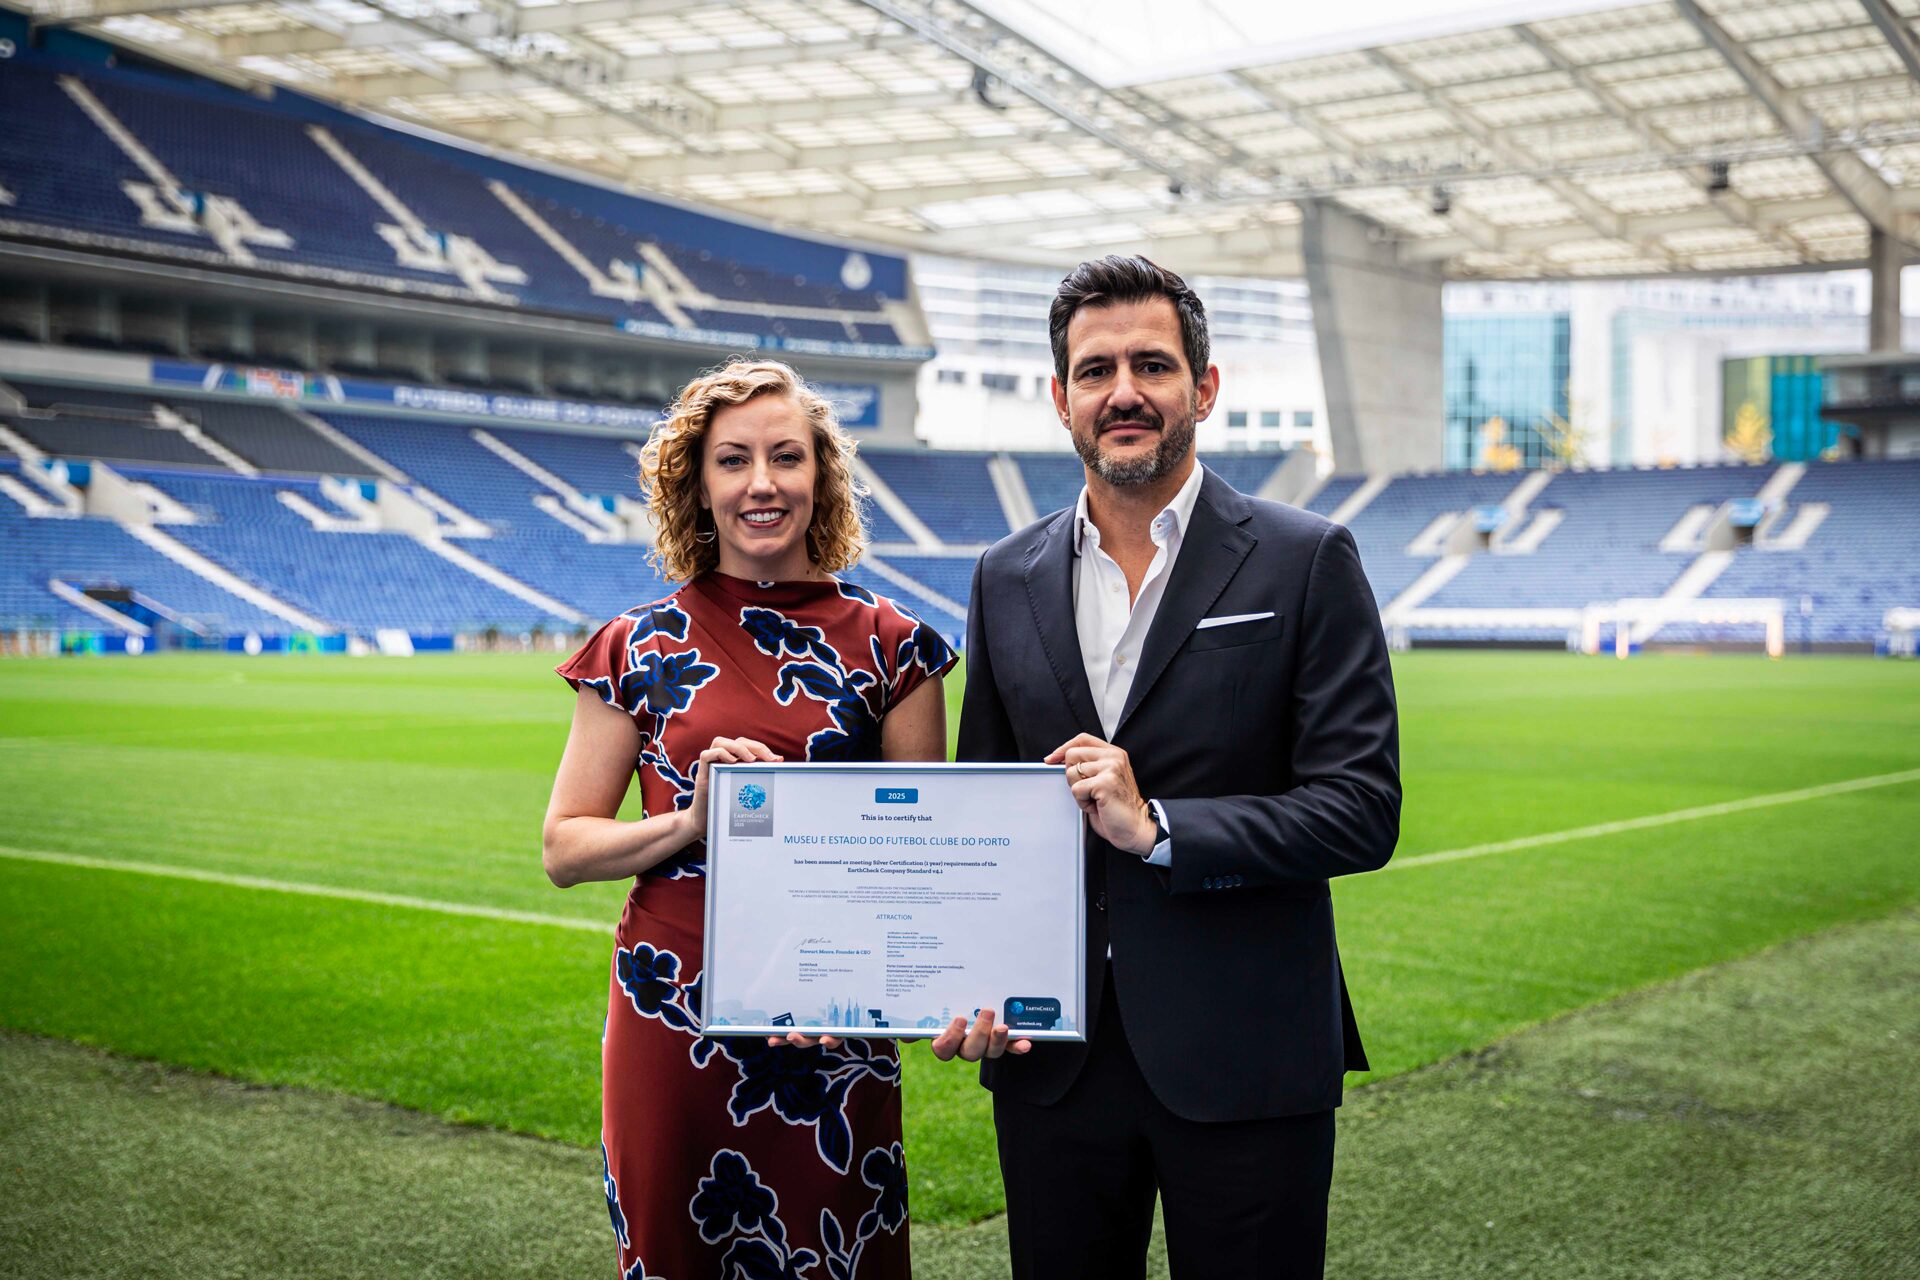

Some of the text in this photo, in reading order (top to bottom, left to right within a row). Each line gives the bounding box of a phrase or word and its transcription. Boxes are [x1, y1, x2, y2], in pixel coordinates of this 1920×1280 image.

[393, 385, 490, 414] FUTEBOL
[784, 836, 1010, 846] MUSEU E ESTADIO DO FUTEBOL CLUBE DO PORTO
